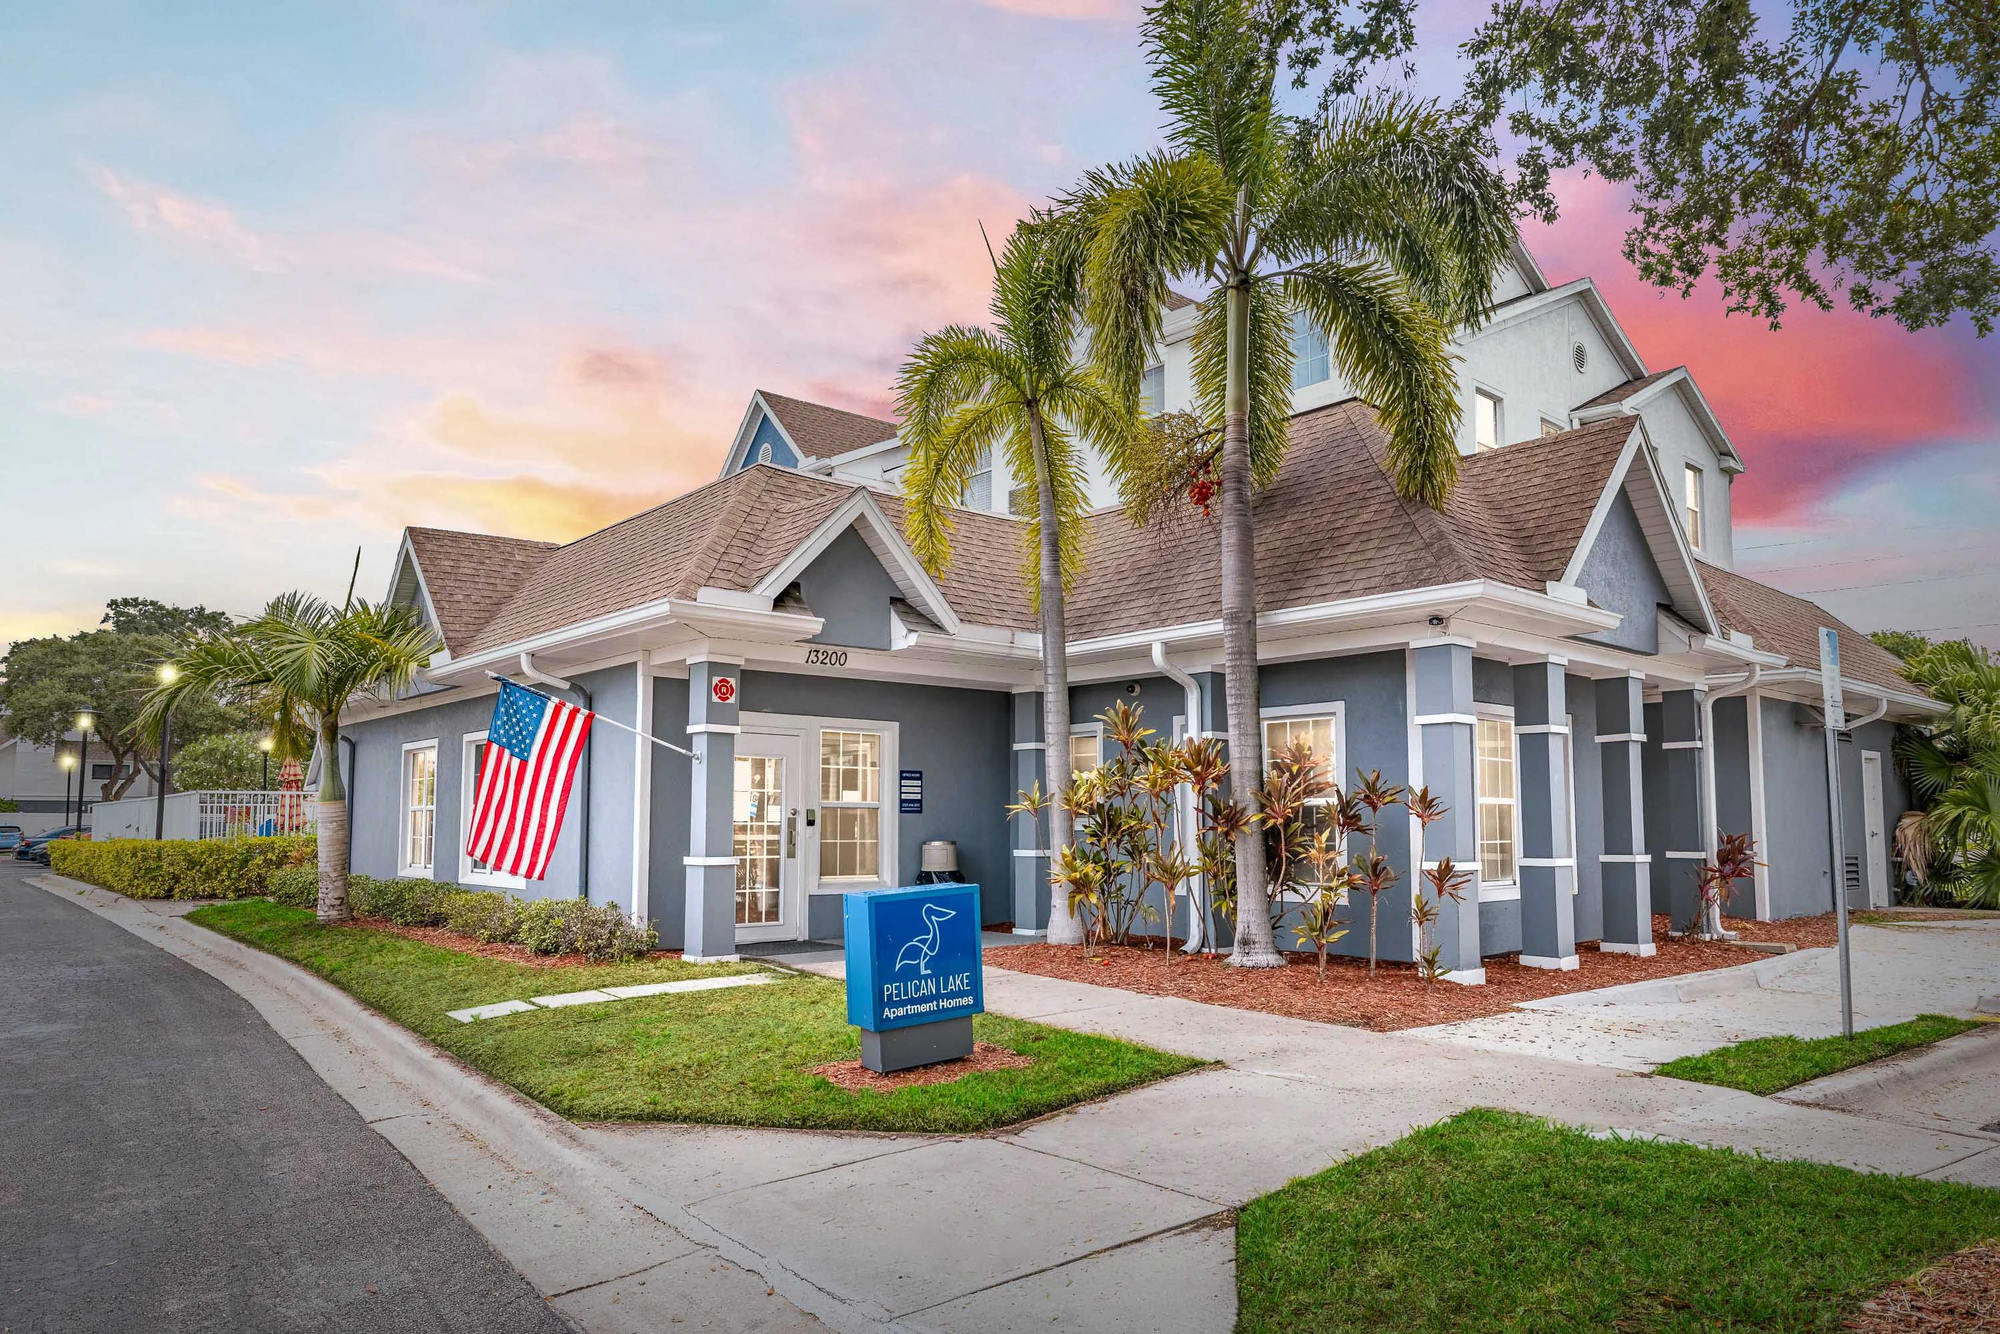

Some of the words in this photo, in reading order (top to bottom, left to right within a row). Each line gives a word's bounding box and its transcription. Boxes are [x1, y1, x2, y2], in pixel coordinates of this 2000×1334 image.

[805, 648, 848, 667] 13200
[884, 977, 936, 1002] PELICAN
[940, 973, 971, 994] LAKE
[883, 1001, 937, 1019] Apartment
[939, 995, 974, 1009] Homes
